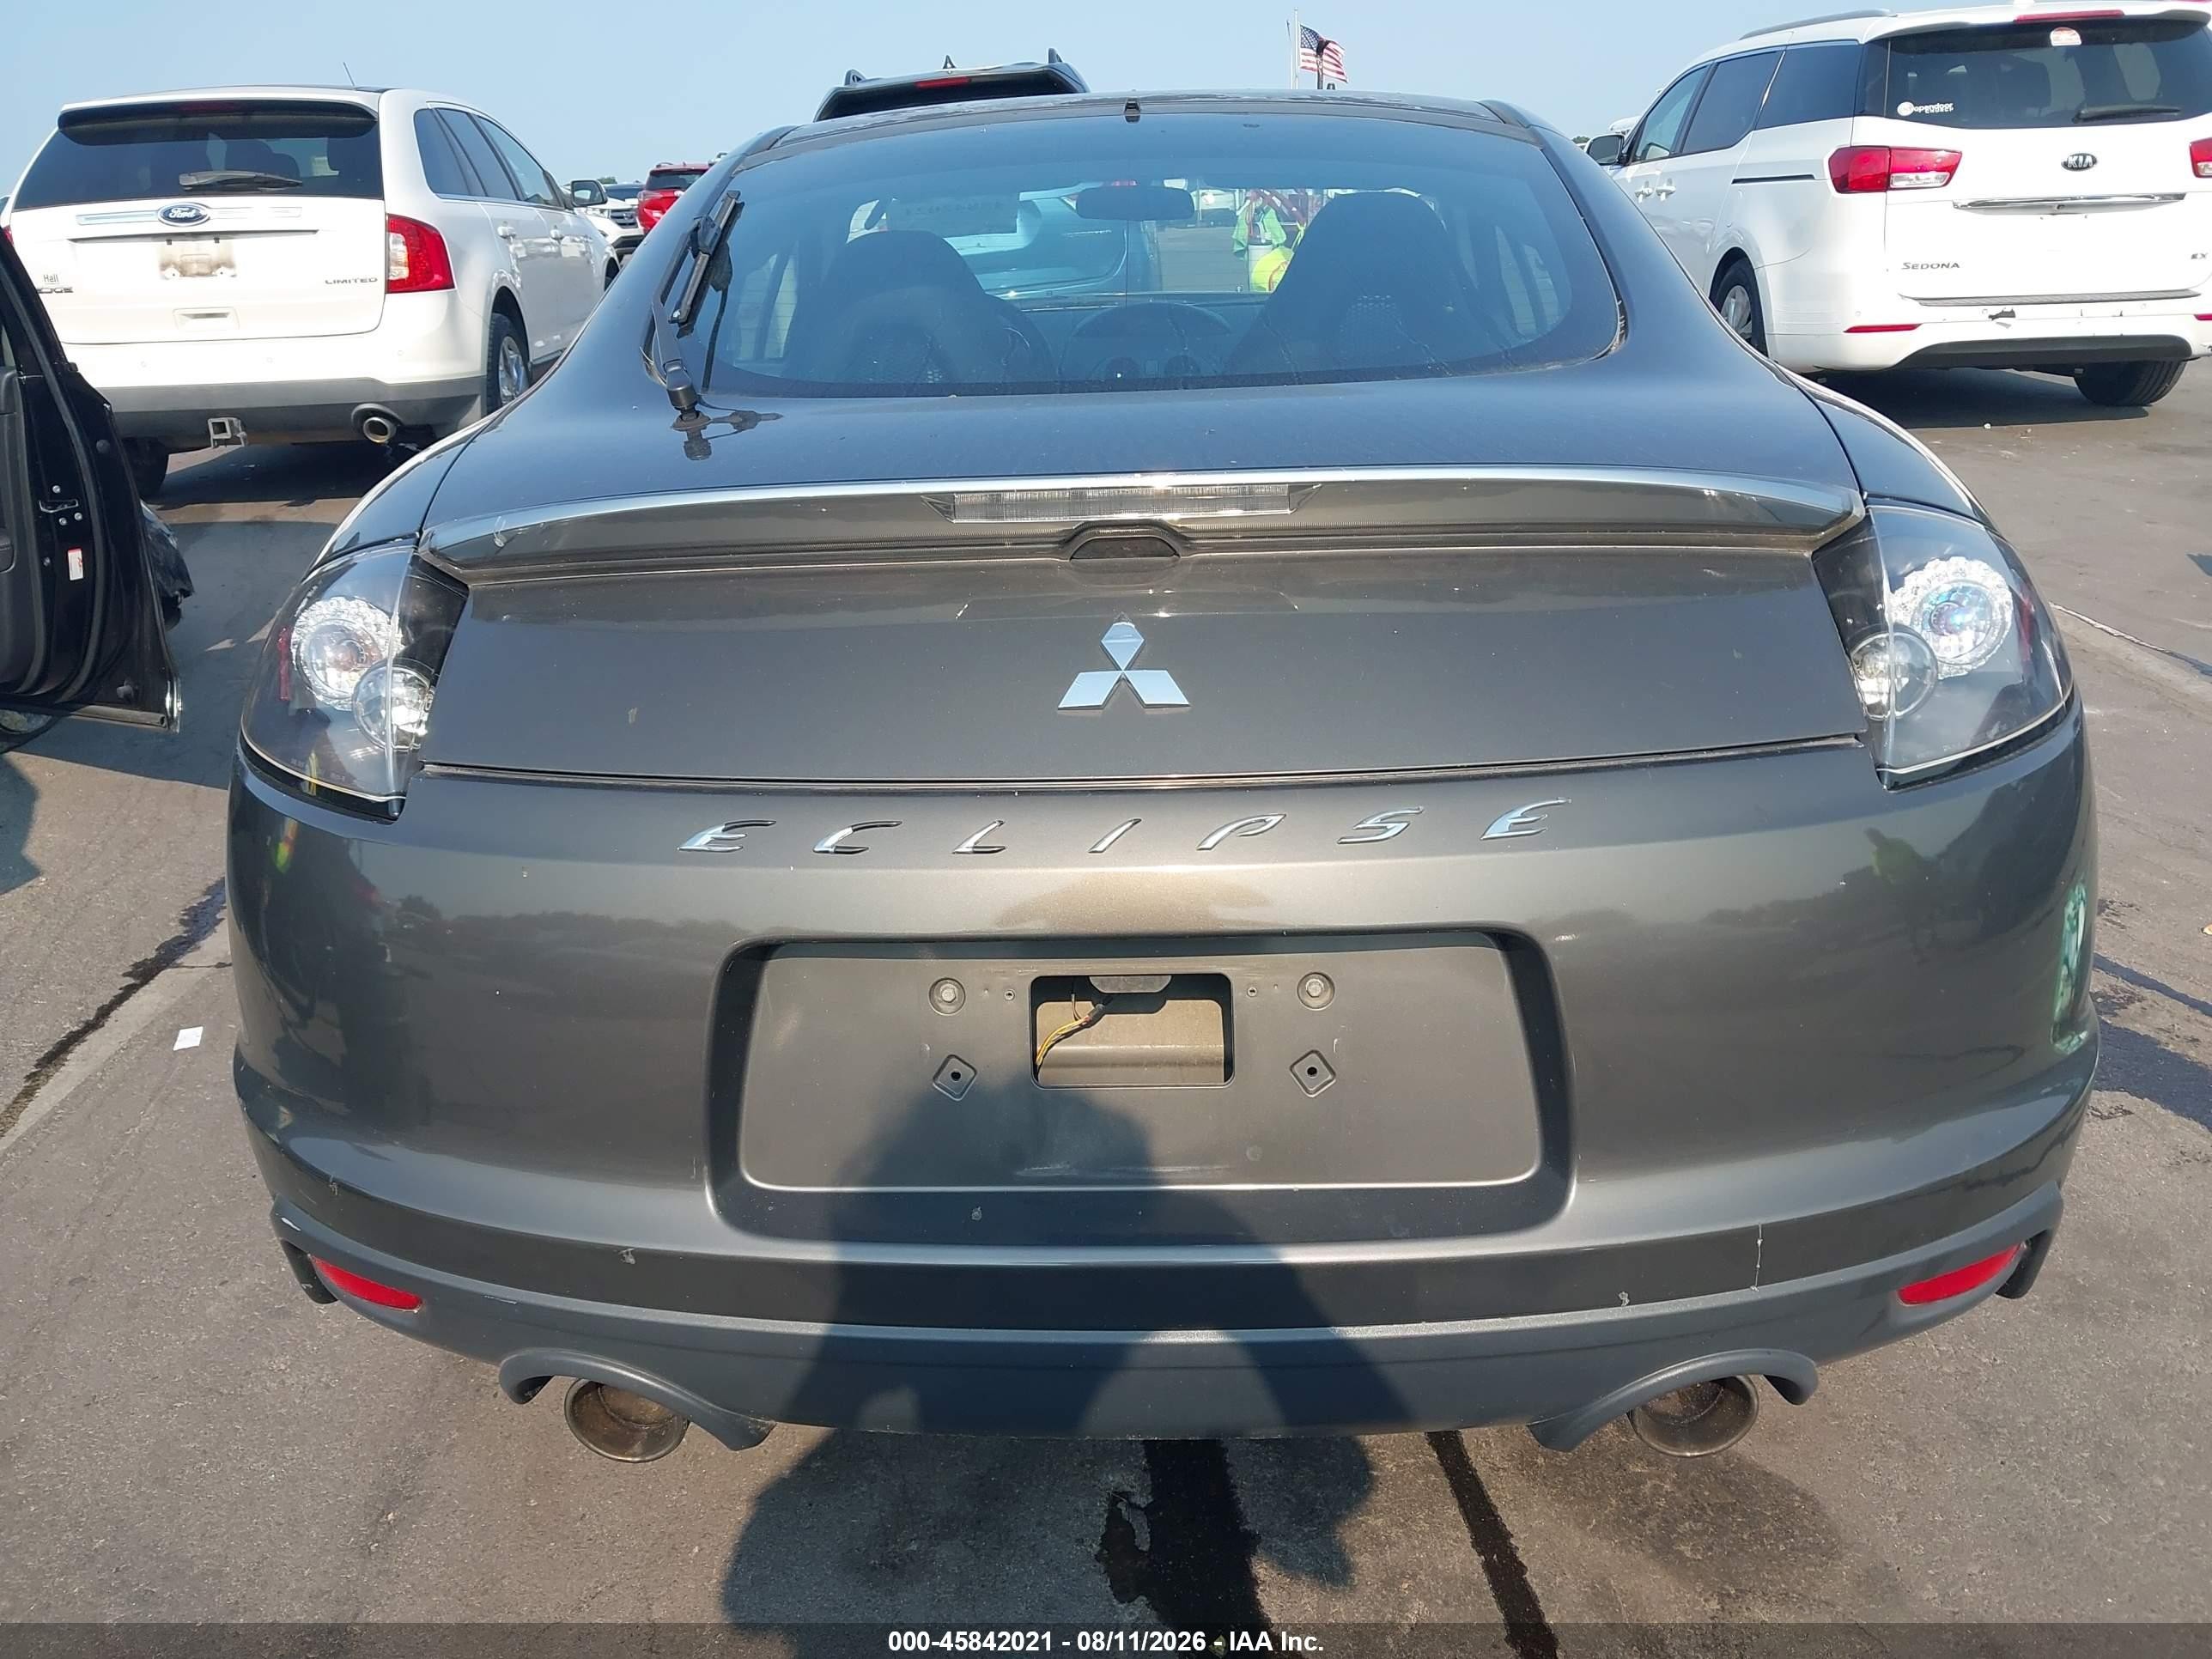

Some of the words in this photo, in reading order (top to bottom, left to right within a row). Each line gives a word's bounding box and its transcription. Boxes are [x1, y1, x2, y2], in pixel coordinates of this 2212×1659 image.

[2068, 155, 2094, 167] KIA
[168, 207, 198, 218] Ford
[43, 274, 59, 283] Hall
[677, 797, 1571, 854] ECLIPSE
